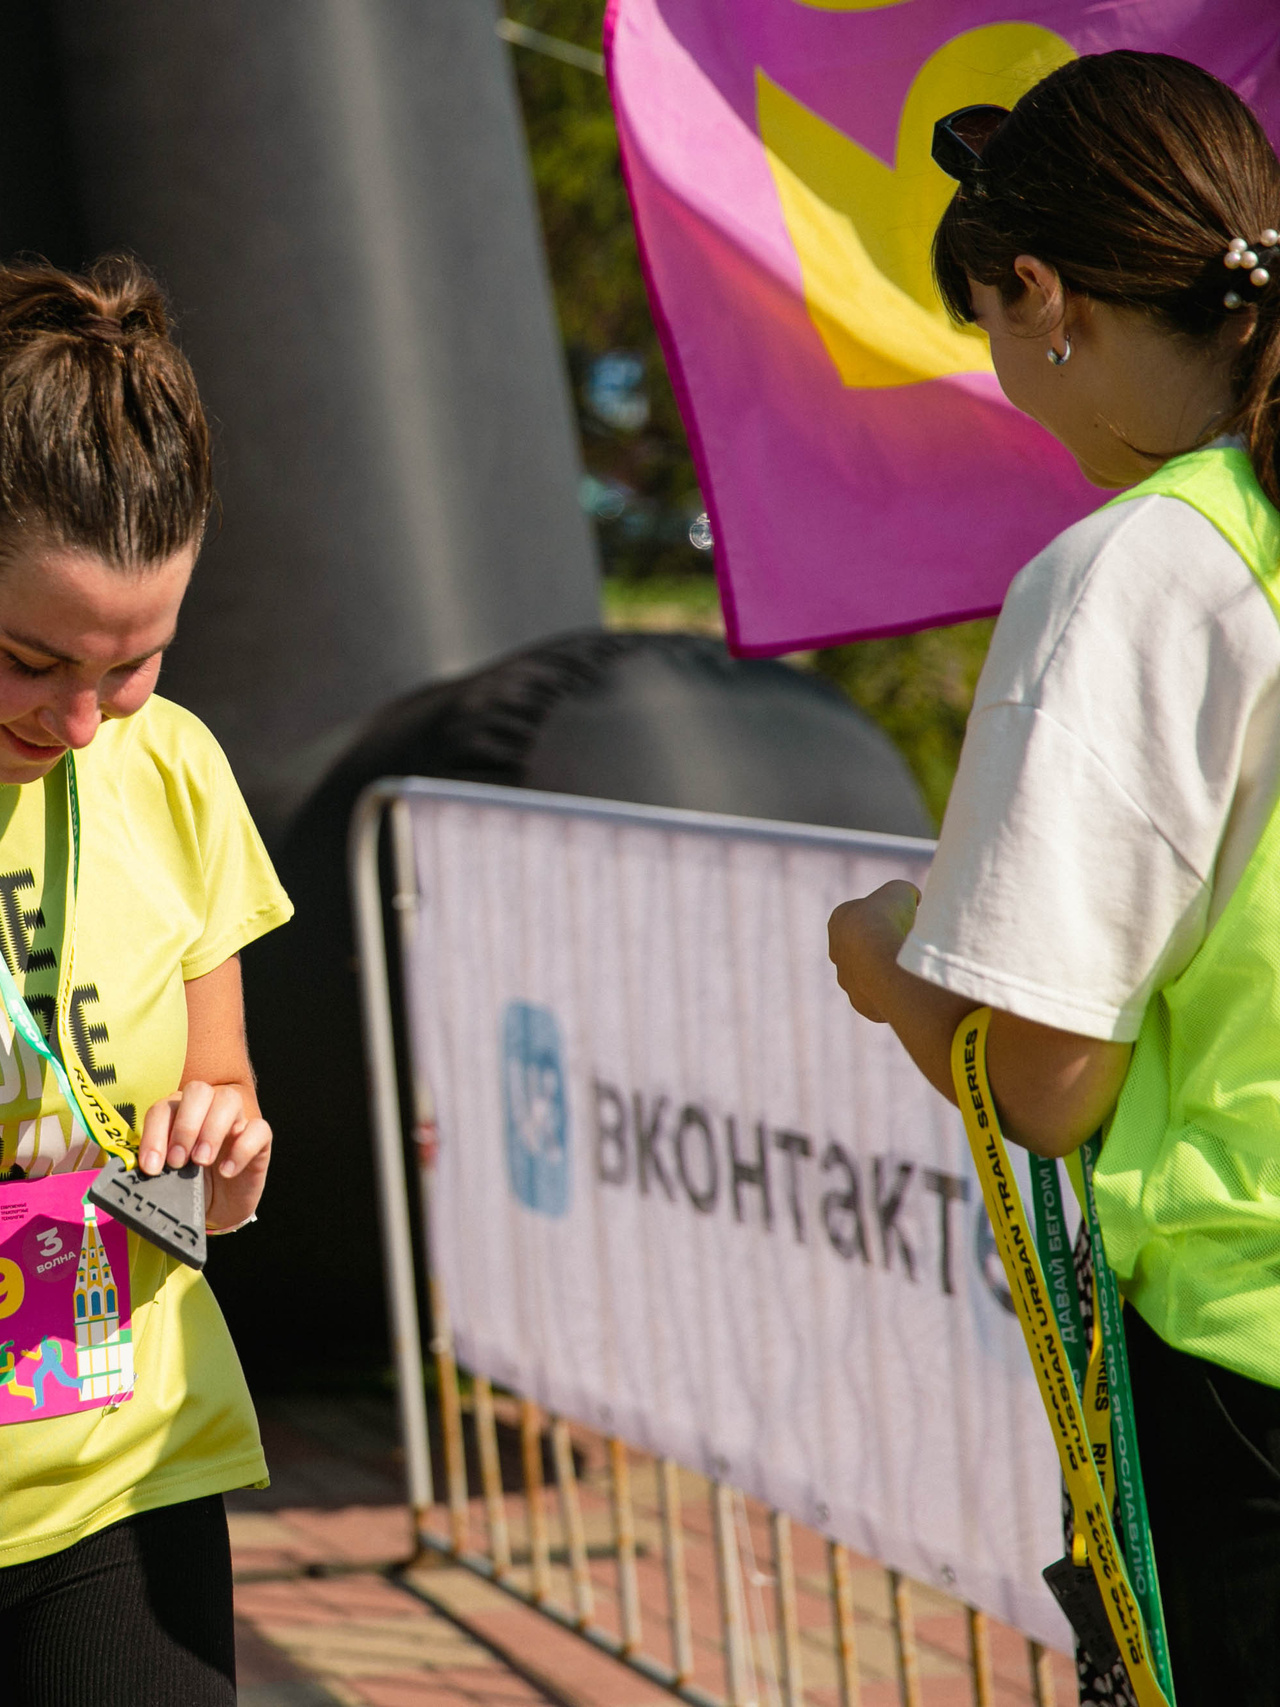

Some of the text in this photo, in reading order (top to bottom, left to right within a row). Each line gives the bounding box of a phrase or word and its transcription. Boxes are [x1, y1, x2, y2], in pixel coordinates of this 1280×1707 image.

[74, 1067, 109, 1125] RUTS
[964, 1028, 989, 1130] SERIES
[985, 1133, 1016, 1220] TRAIL
[1038, 1167, 1065, 1252] БЕГОМ
[36, 1227, 64, 1257] 3
[36, 1251, 77, 1274] ВОЛНА
[1010, 1225, 1048, 1327] URBAN
[1094, 1232, 1111, 1337] БЕГОМ
[1048, 1257, 1079, 1344] ДАВАЙ
[1044, 1334, 1088, 1464] RUSSIAN
[1106, 1343, 1118, 1388] ПО
[1111, 1393, 1146, 1597] ЯРОСЛАВЛЮ
